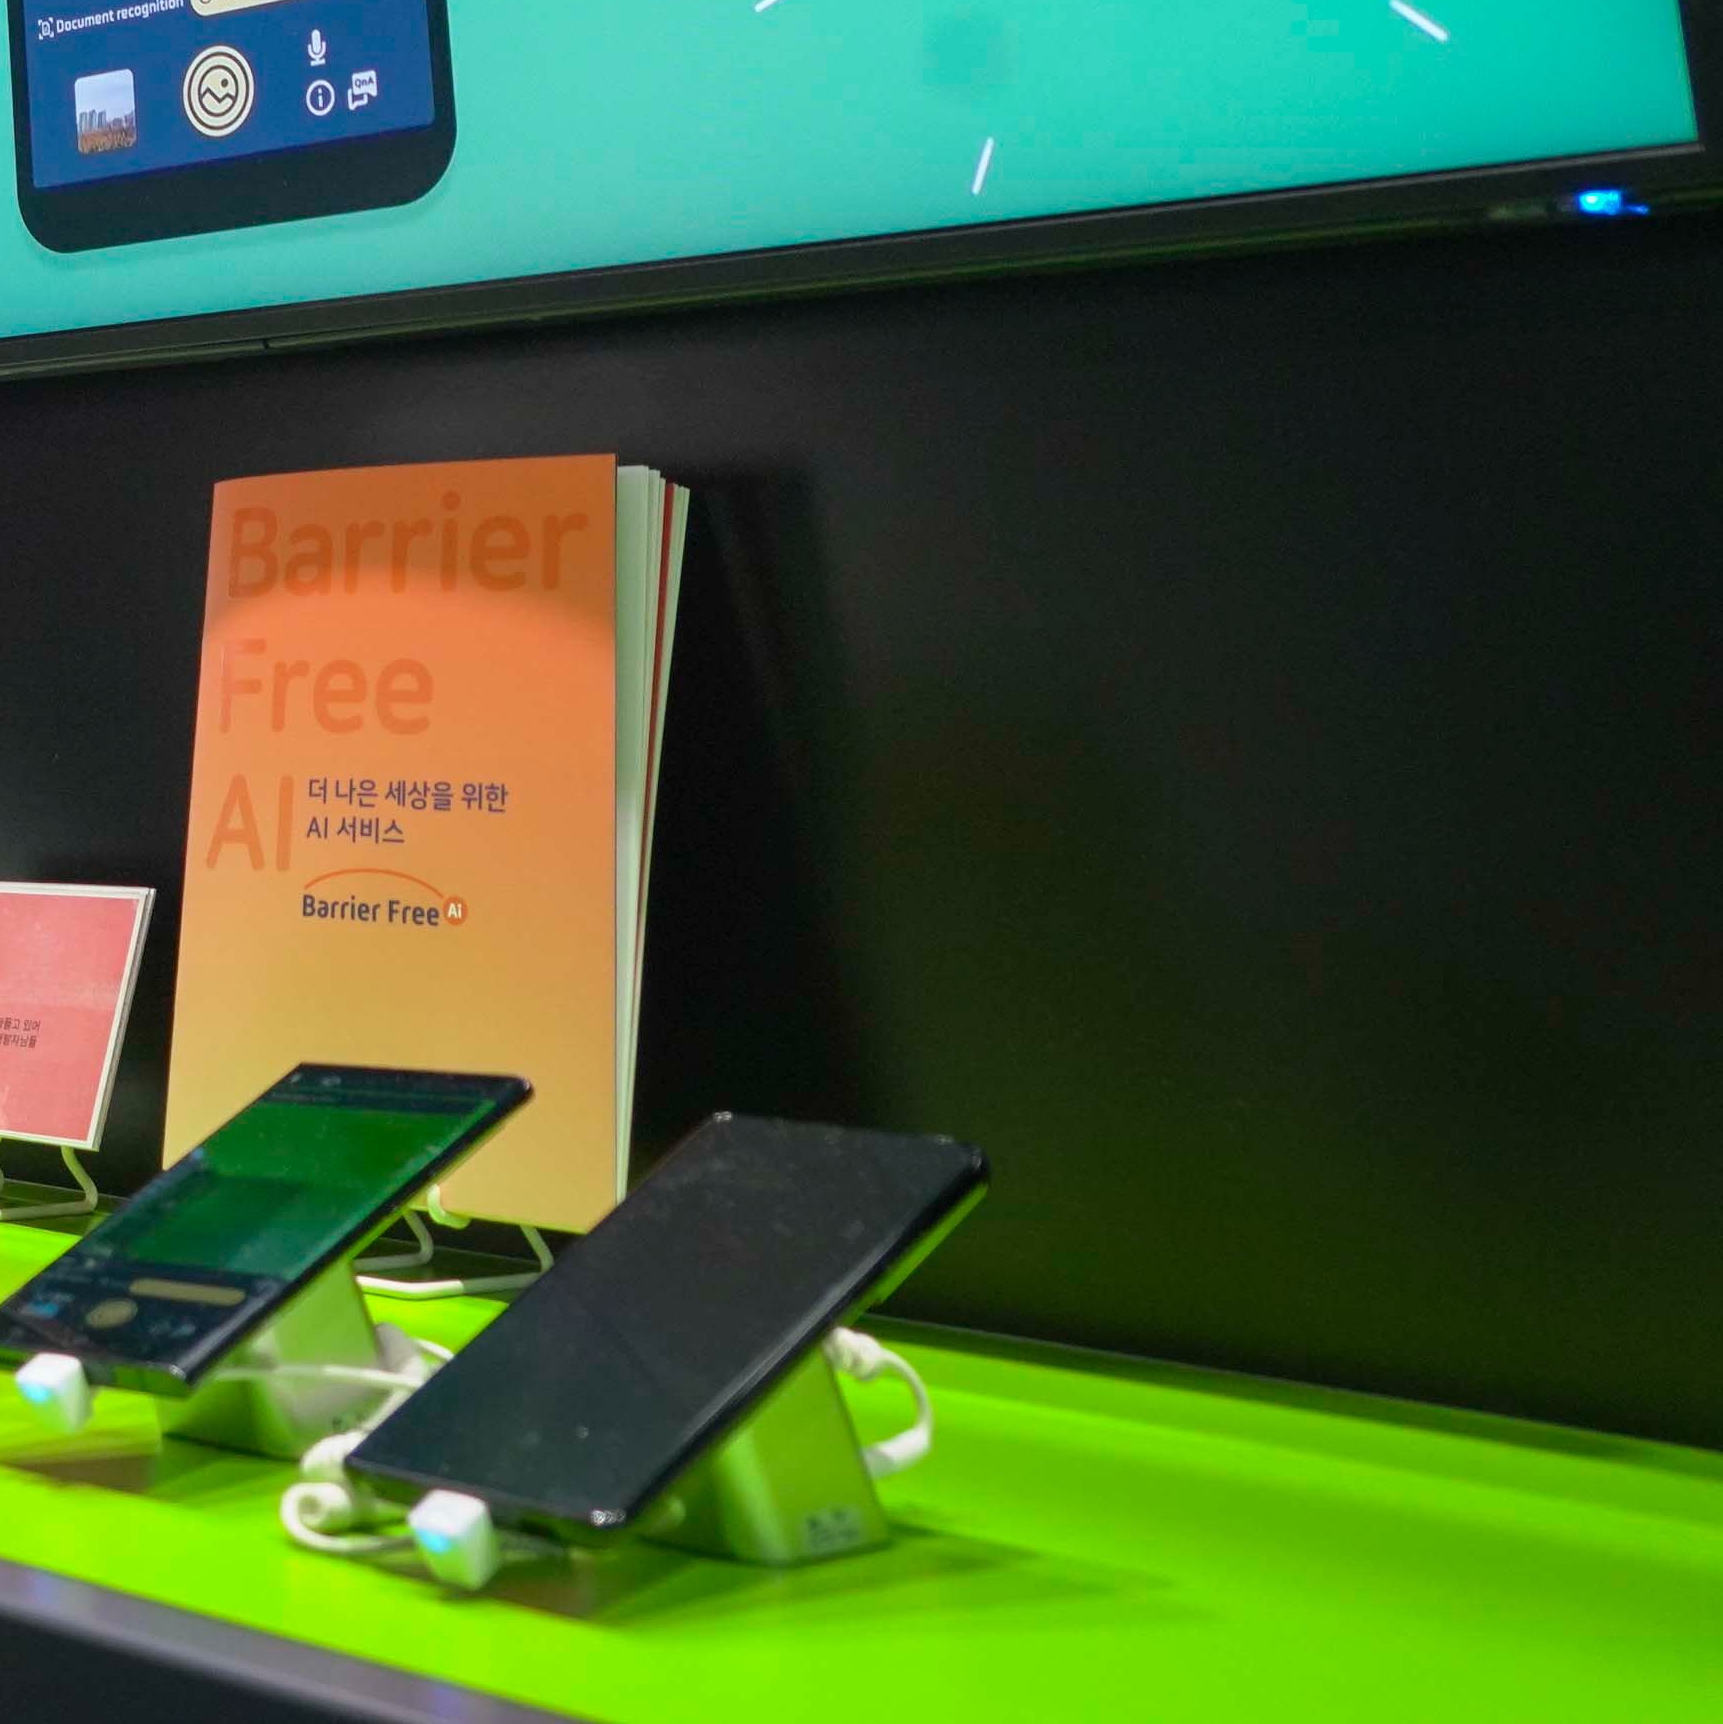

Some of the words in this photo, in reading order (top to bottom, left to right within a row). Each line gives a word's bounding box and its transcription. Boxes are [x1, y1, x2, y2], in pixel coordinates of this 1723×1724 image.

[55, 8, 115, 34] Document
[355, 77, 375, 90] QnA
[228, 490, 589, 599] Barrier
[218, 638, 434, 735] Free
[308, 778, 328, 801] 더
[334, 778, 378, 809] 나은
[384, 782, 453, 811] 세상을
[461, 783, 509, 813] 위한
[205, 775, 295, 871] AI
[306, 819, 329, 840] AI
[336, 816, 405, 844] 서비스
[302, 894, 381, 924] Barrier
[388, 899, 440, 927] Free
[447, 902, 463, 919] Ai
